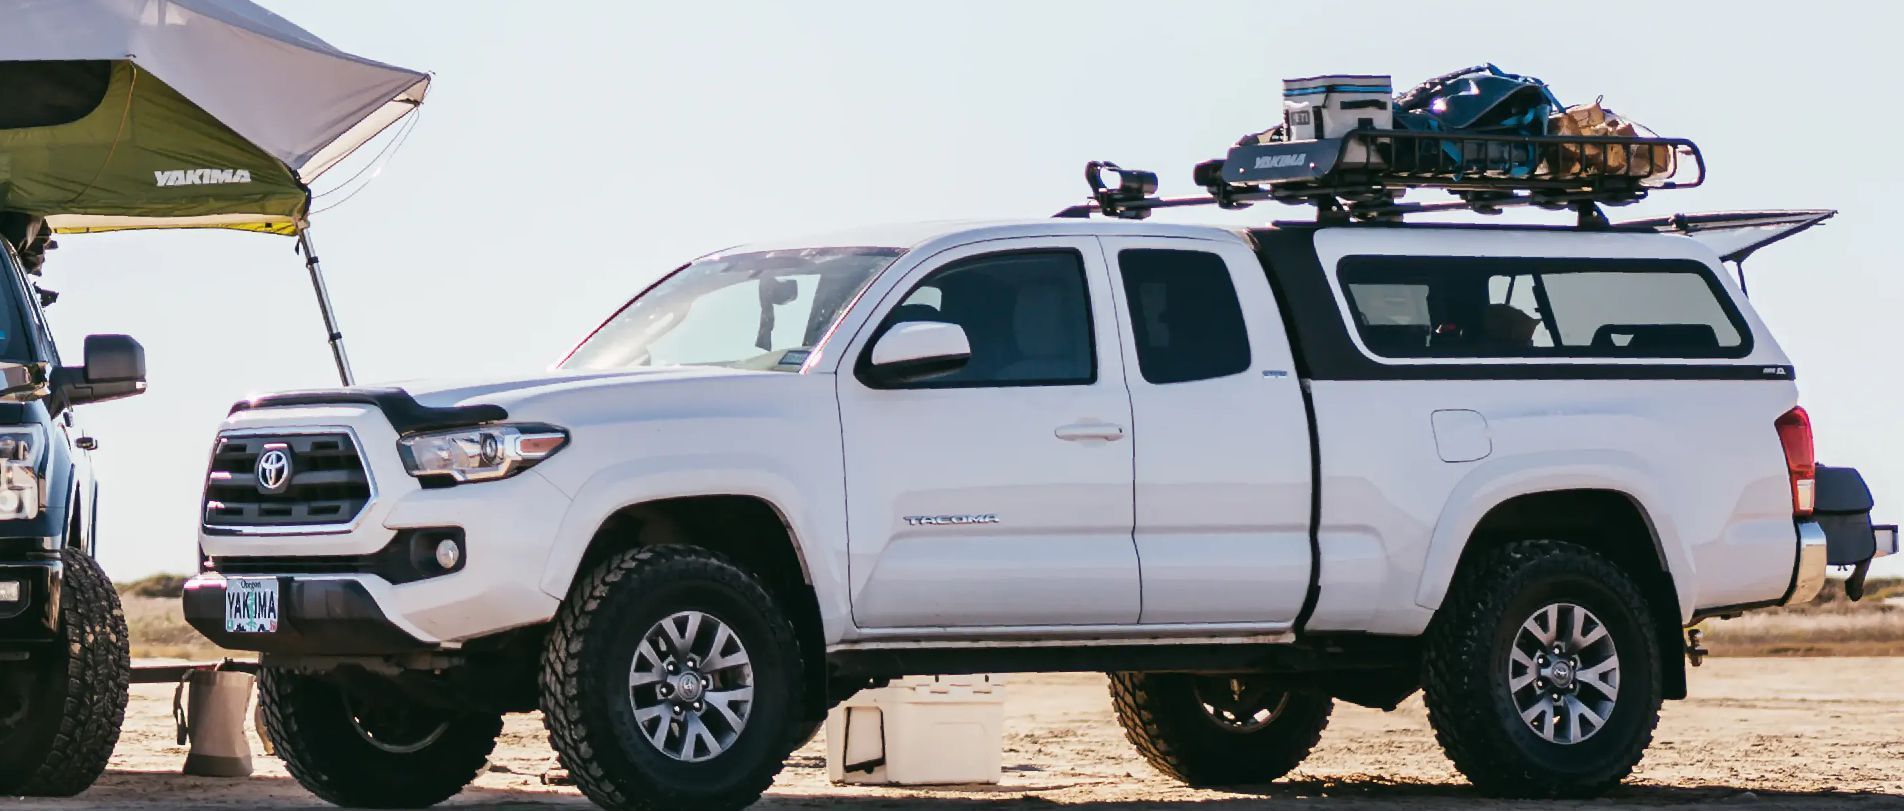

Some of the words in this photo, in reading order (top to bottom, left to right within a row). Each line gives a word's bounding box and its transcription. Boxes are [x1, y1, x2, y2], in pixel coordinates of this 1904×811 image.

[1254, 153, 1306, 169] YAKIMA
[154, 168, 251, 187] YAKIMA
[903, 514, 1000, 526] TACOMA
[240, 580, 262, 591] Oregon
[227, 591, 277, 619] YAKIMA
